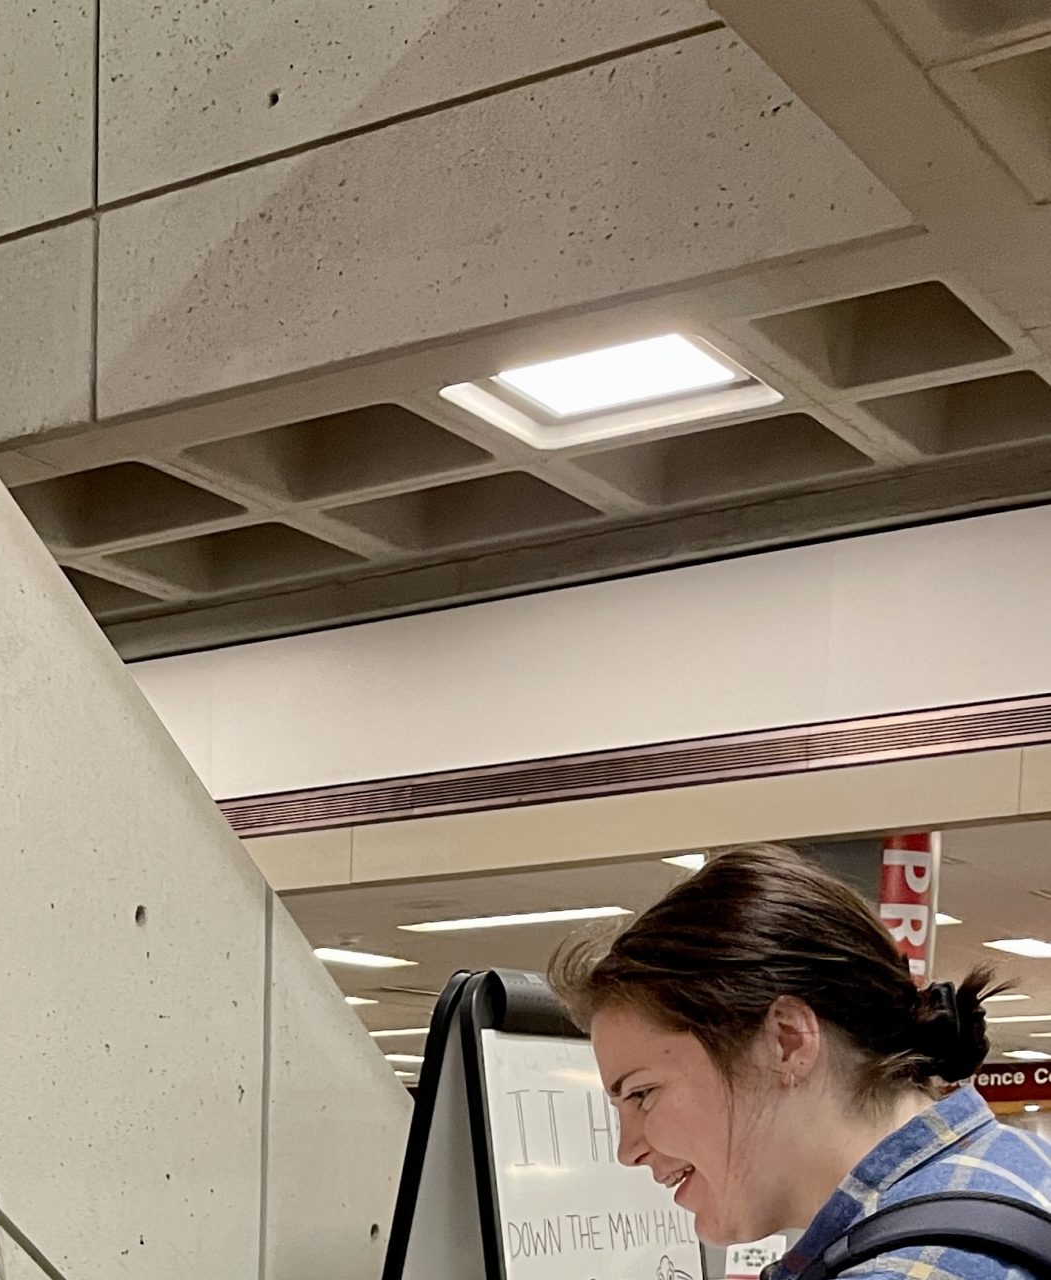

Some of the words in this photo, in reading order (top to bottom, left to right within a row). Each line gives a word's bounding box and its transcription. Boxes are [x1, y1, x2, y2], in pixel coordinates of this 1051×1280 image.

[970, 1071, 1025, 1087] rence
[1034, 1067, 1051, 1085] C
[506, 1089, 565, 1167] IT
[508, 1215, 561, 1261] DOWN
[566, 1214, 603, 1250] THE
[608, 1210, 649, 1251] MAIN
[653, 1208, 695, 1246] HALL
